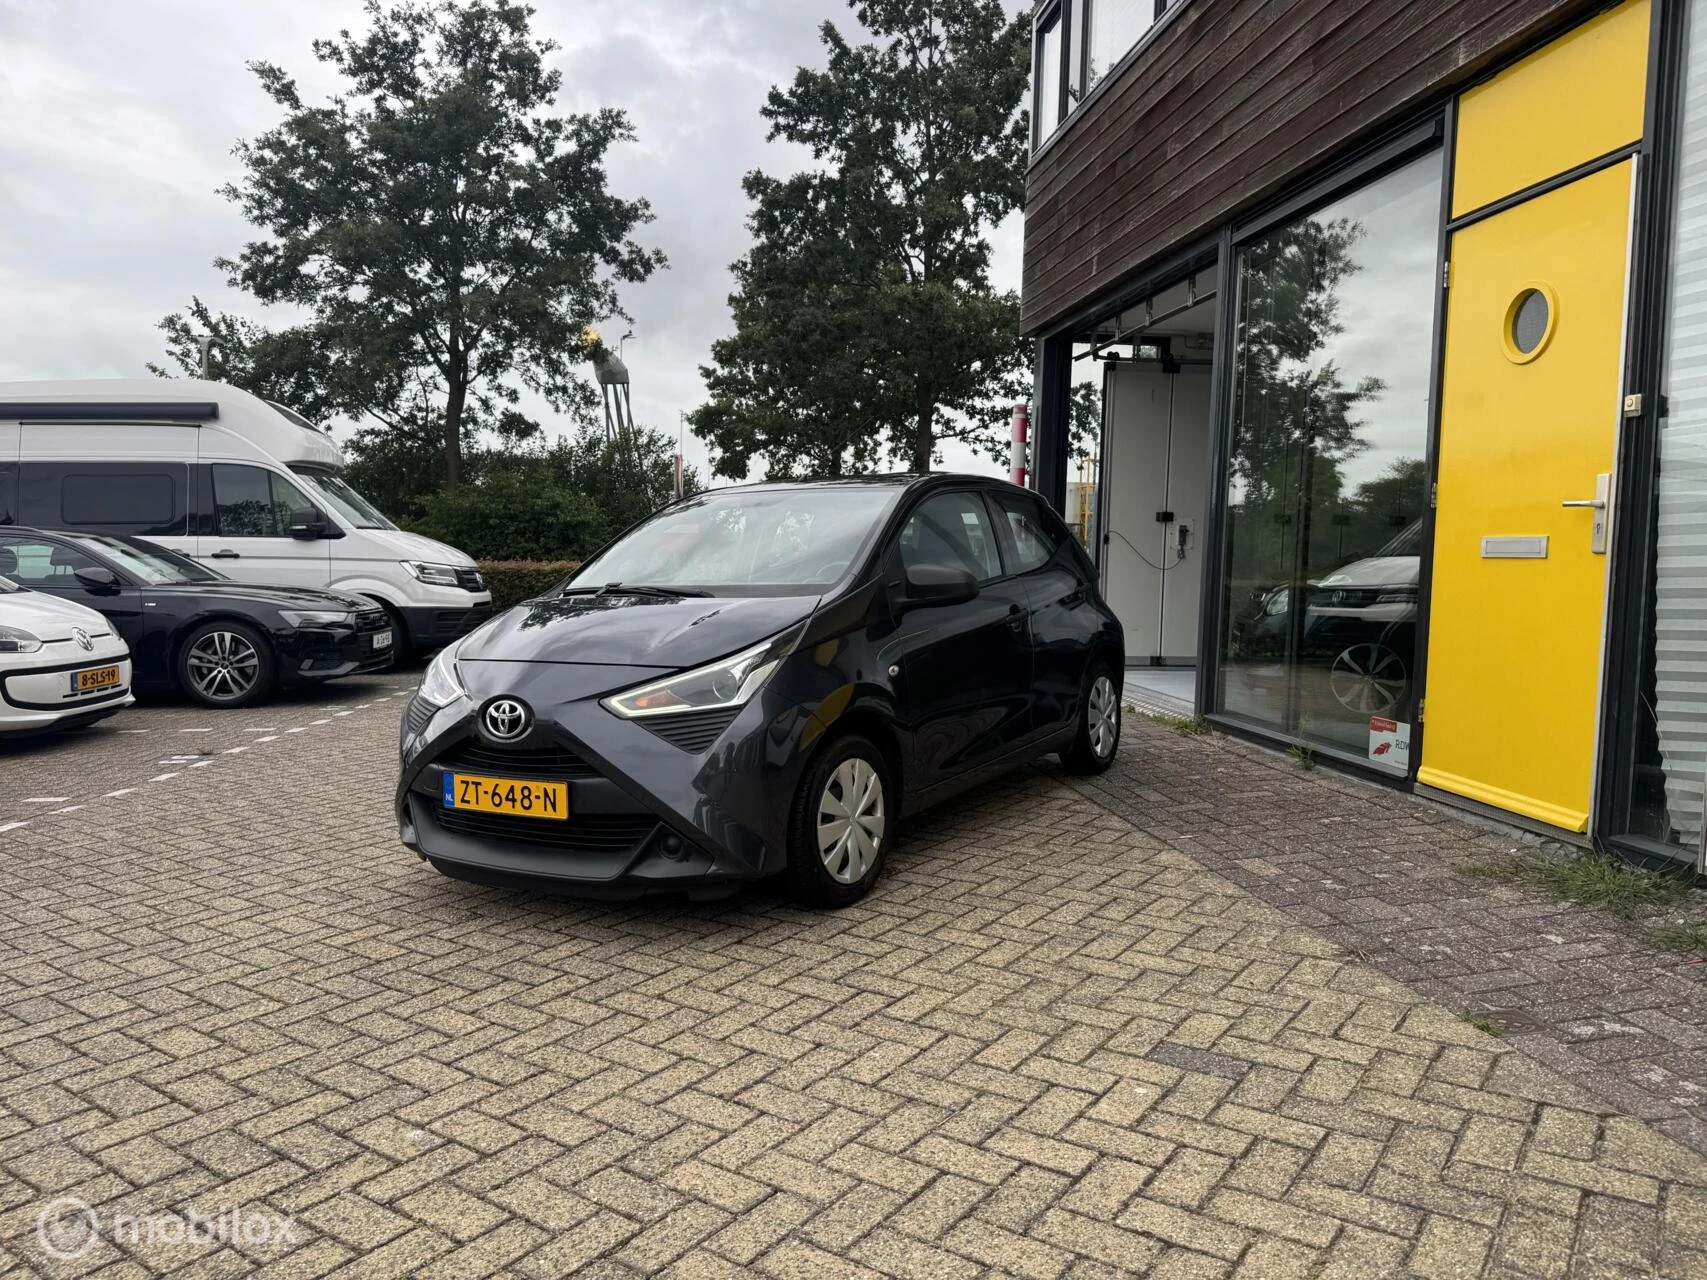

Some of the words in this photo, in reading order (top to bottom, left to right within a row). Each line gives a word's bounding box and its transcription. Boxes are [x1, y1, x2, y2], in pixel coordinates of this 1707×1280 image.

[81, 669, 116, 687] 8-SLS-19
[445, 793, 454, 801] NL
[460, 780, 557, 813] ZT-648-N
